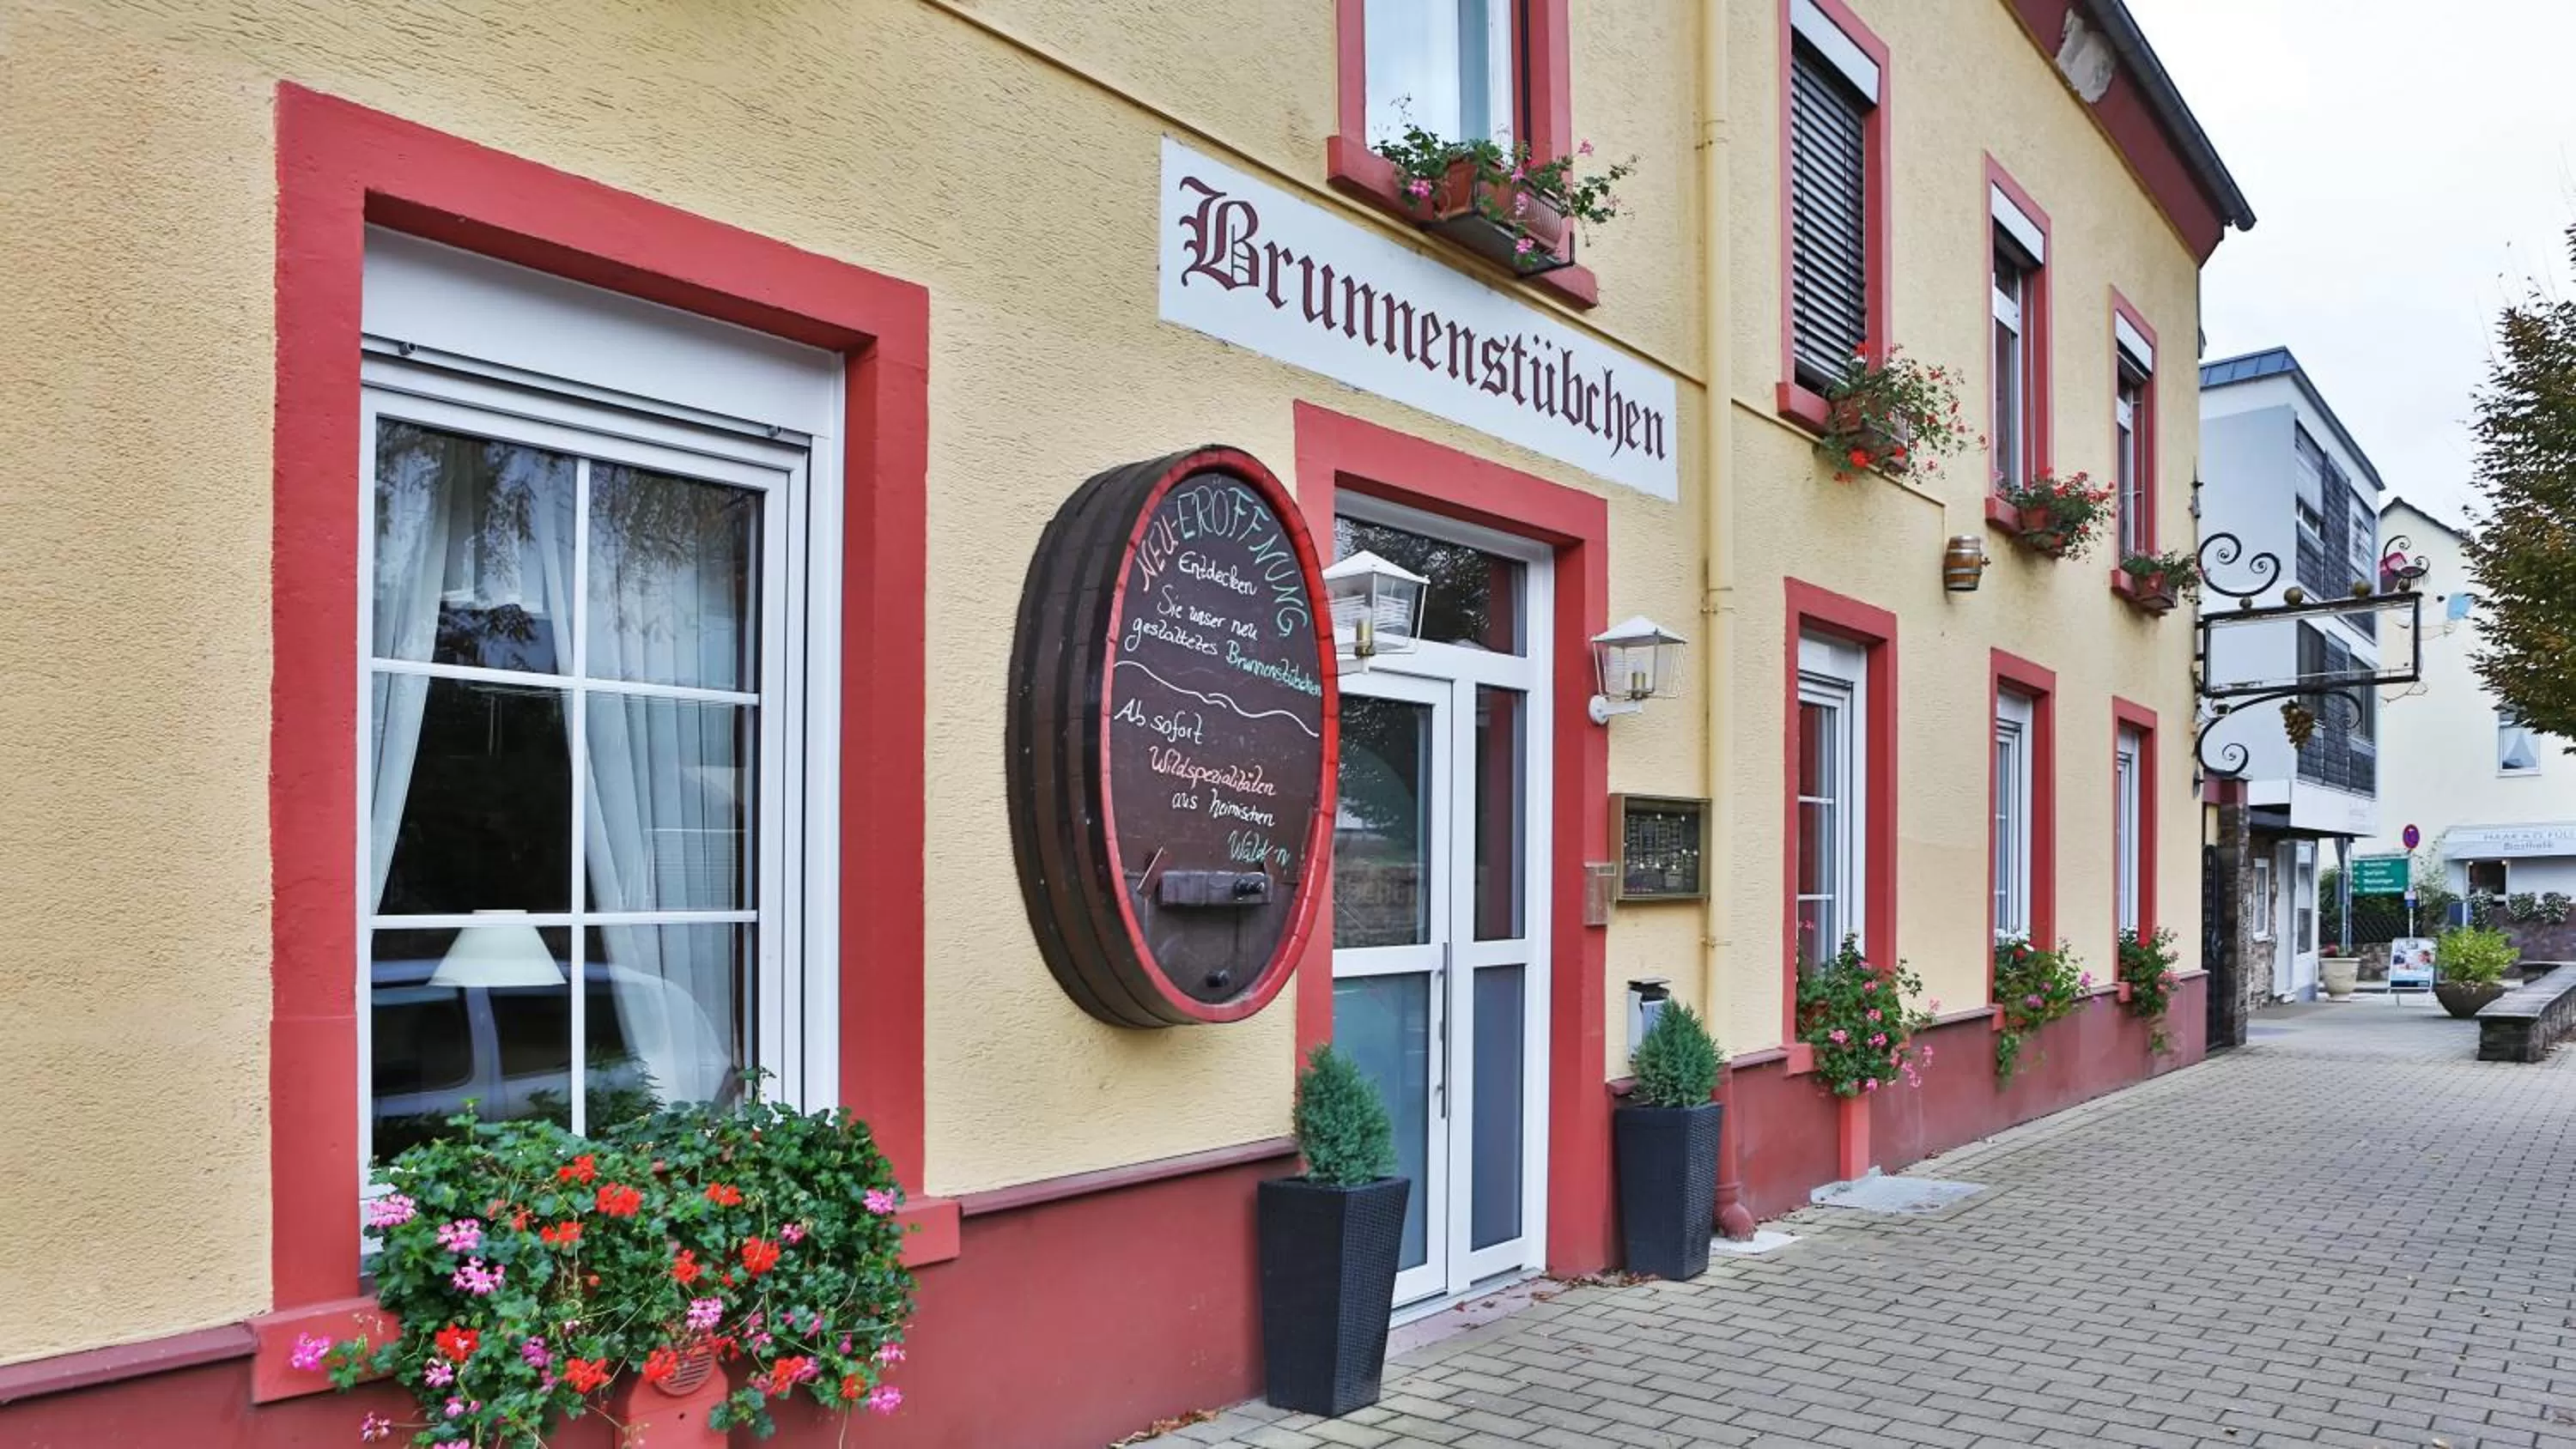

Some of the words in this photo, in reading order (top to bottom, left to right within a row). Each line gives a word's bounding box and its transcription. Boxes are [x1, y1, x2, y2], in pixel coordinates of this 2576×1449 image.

[1178, 176, 1666, 460] Brunnenstübchen
[1178, 550, 1257, 596] Entdecken
[1156, 584, 1182, 619] Sie
[1189, 605, 1225, 628] unser
[1230, 617, 1259, 640] neu
[1224, 639, 1322, 697] Brunnenstübchen
[1114, 698, 1146, 727] Ab
[1150, 711, 1203, 744] sofort
[1148, 745, 1277, 797] Wildspezialitäten
[1170, 791, 1199, 809] aus
[1208, 788, 1275, 827] heimischen
